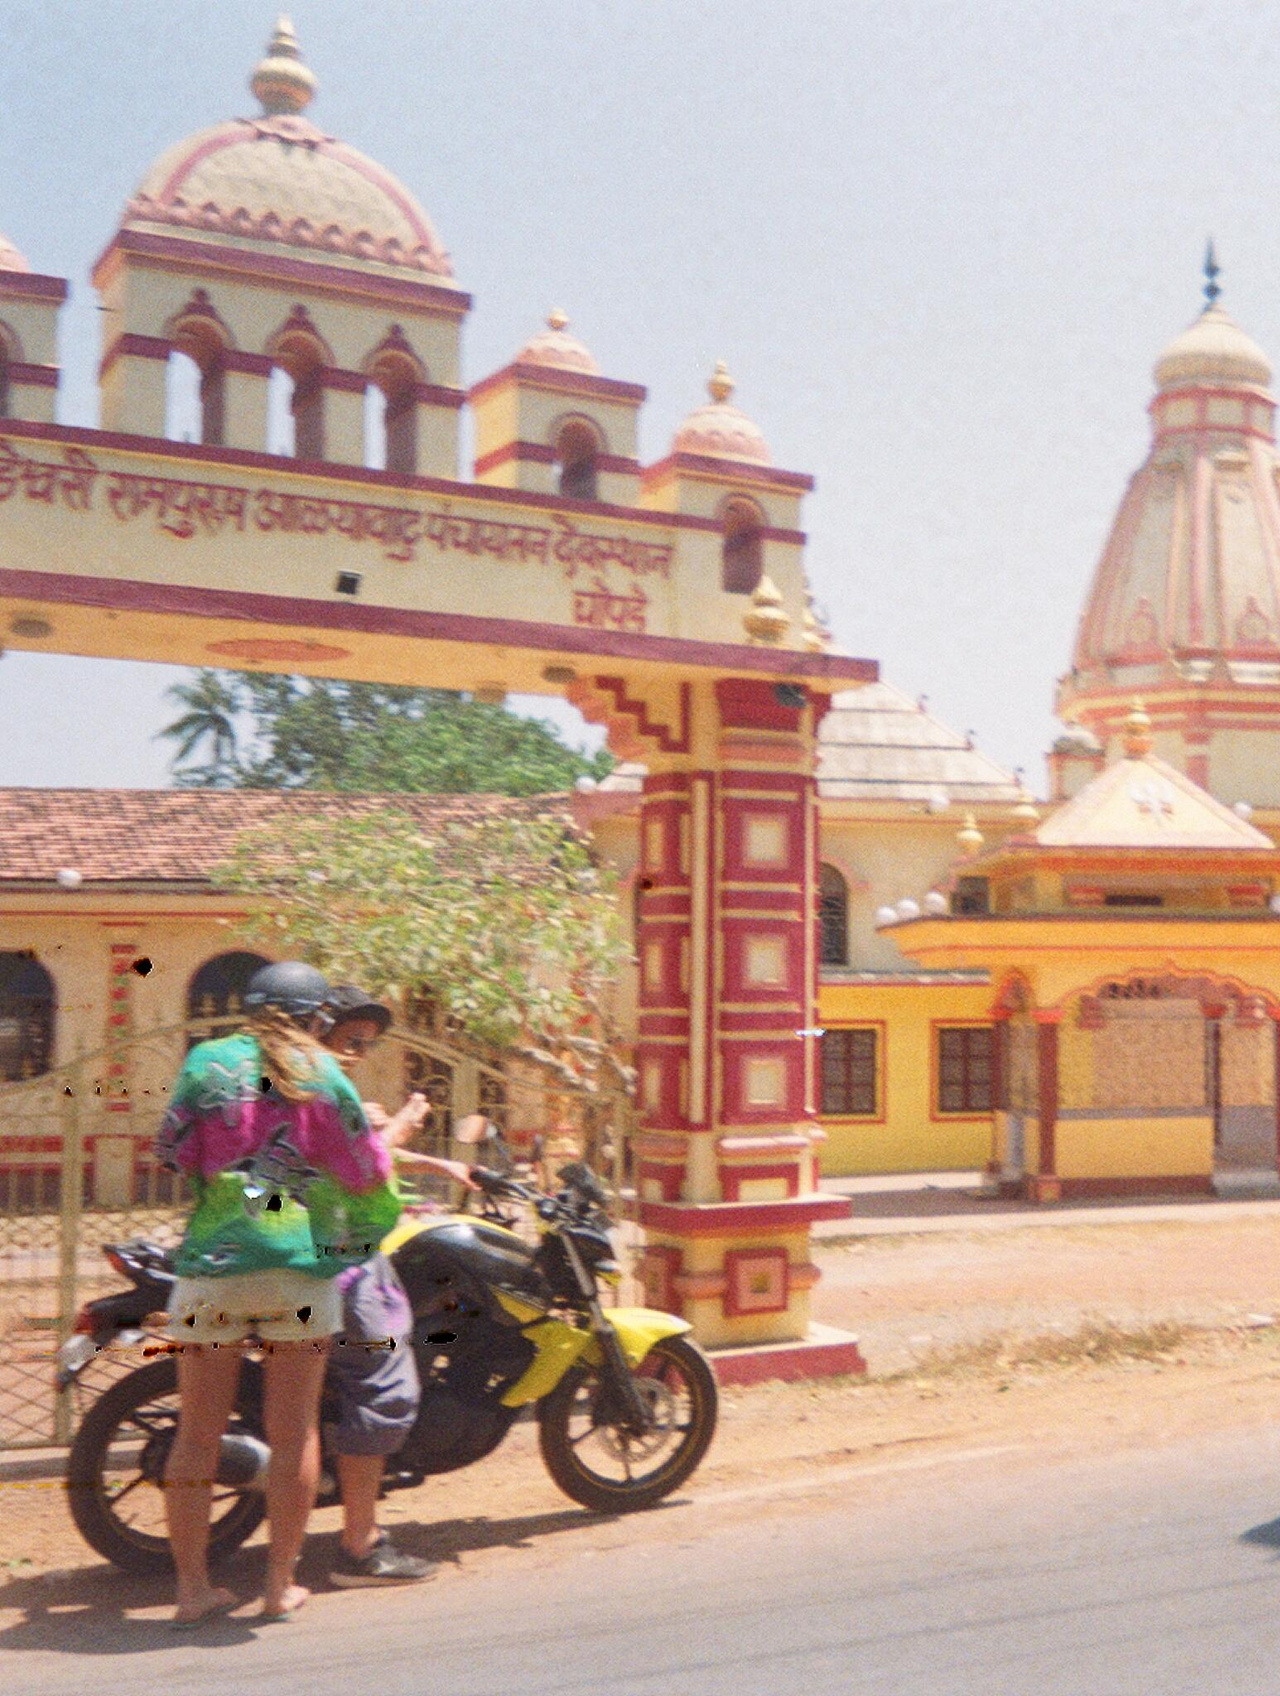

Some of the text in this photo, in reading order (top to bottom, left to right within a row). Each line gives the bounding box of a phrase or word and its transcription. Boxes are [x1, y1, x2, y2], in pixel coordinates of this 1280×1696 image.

[426, 502, 550, 566] पंचायतन
[552, 513, 673, 579] देवस्थान
[572, 578, 648, 633] चोपडे
